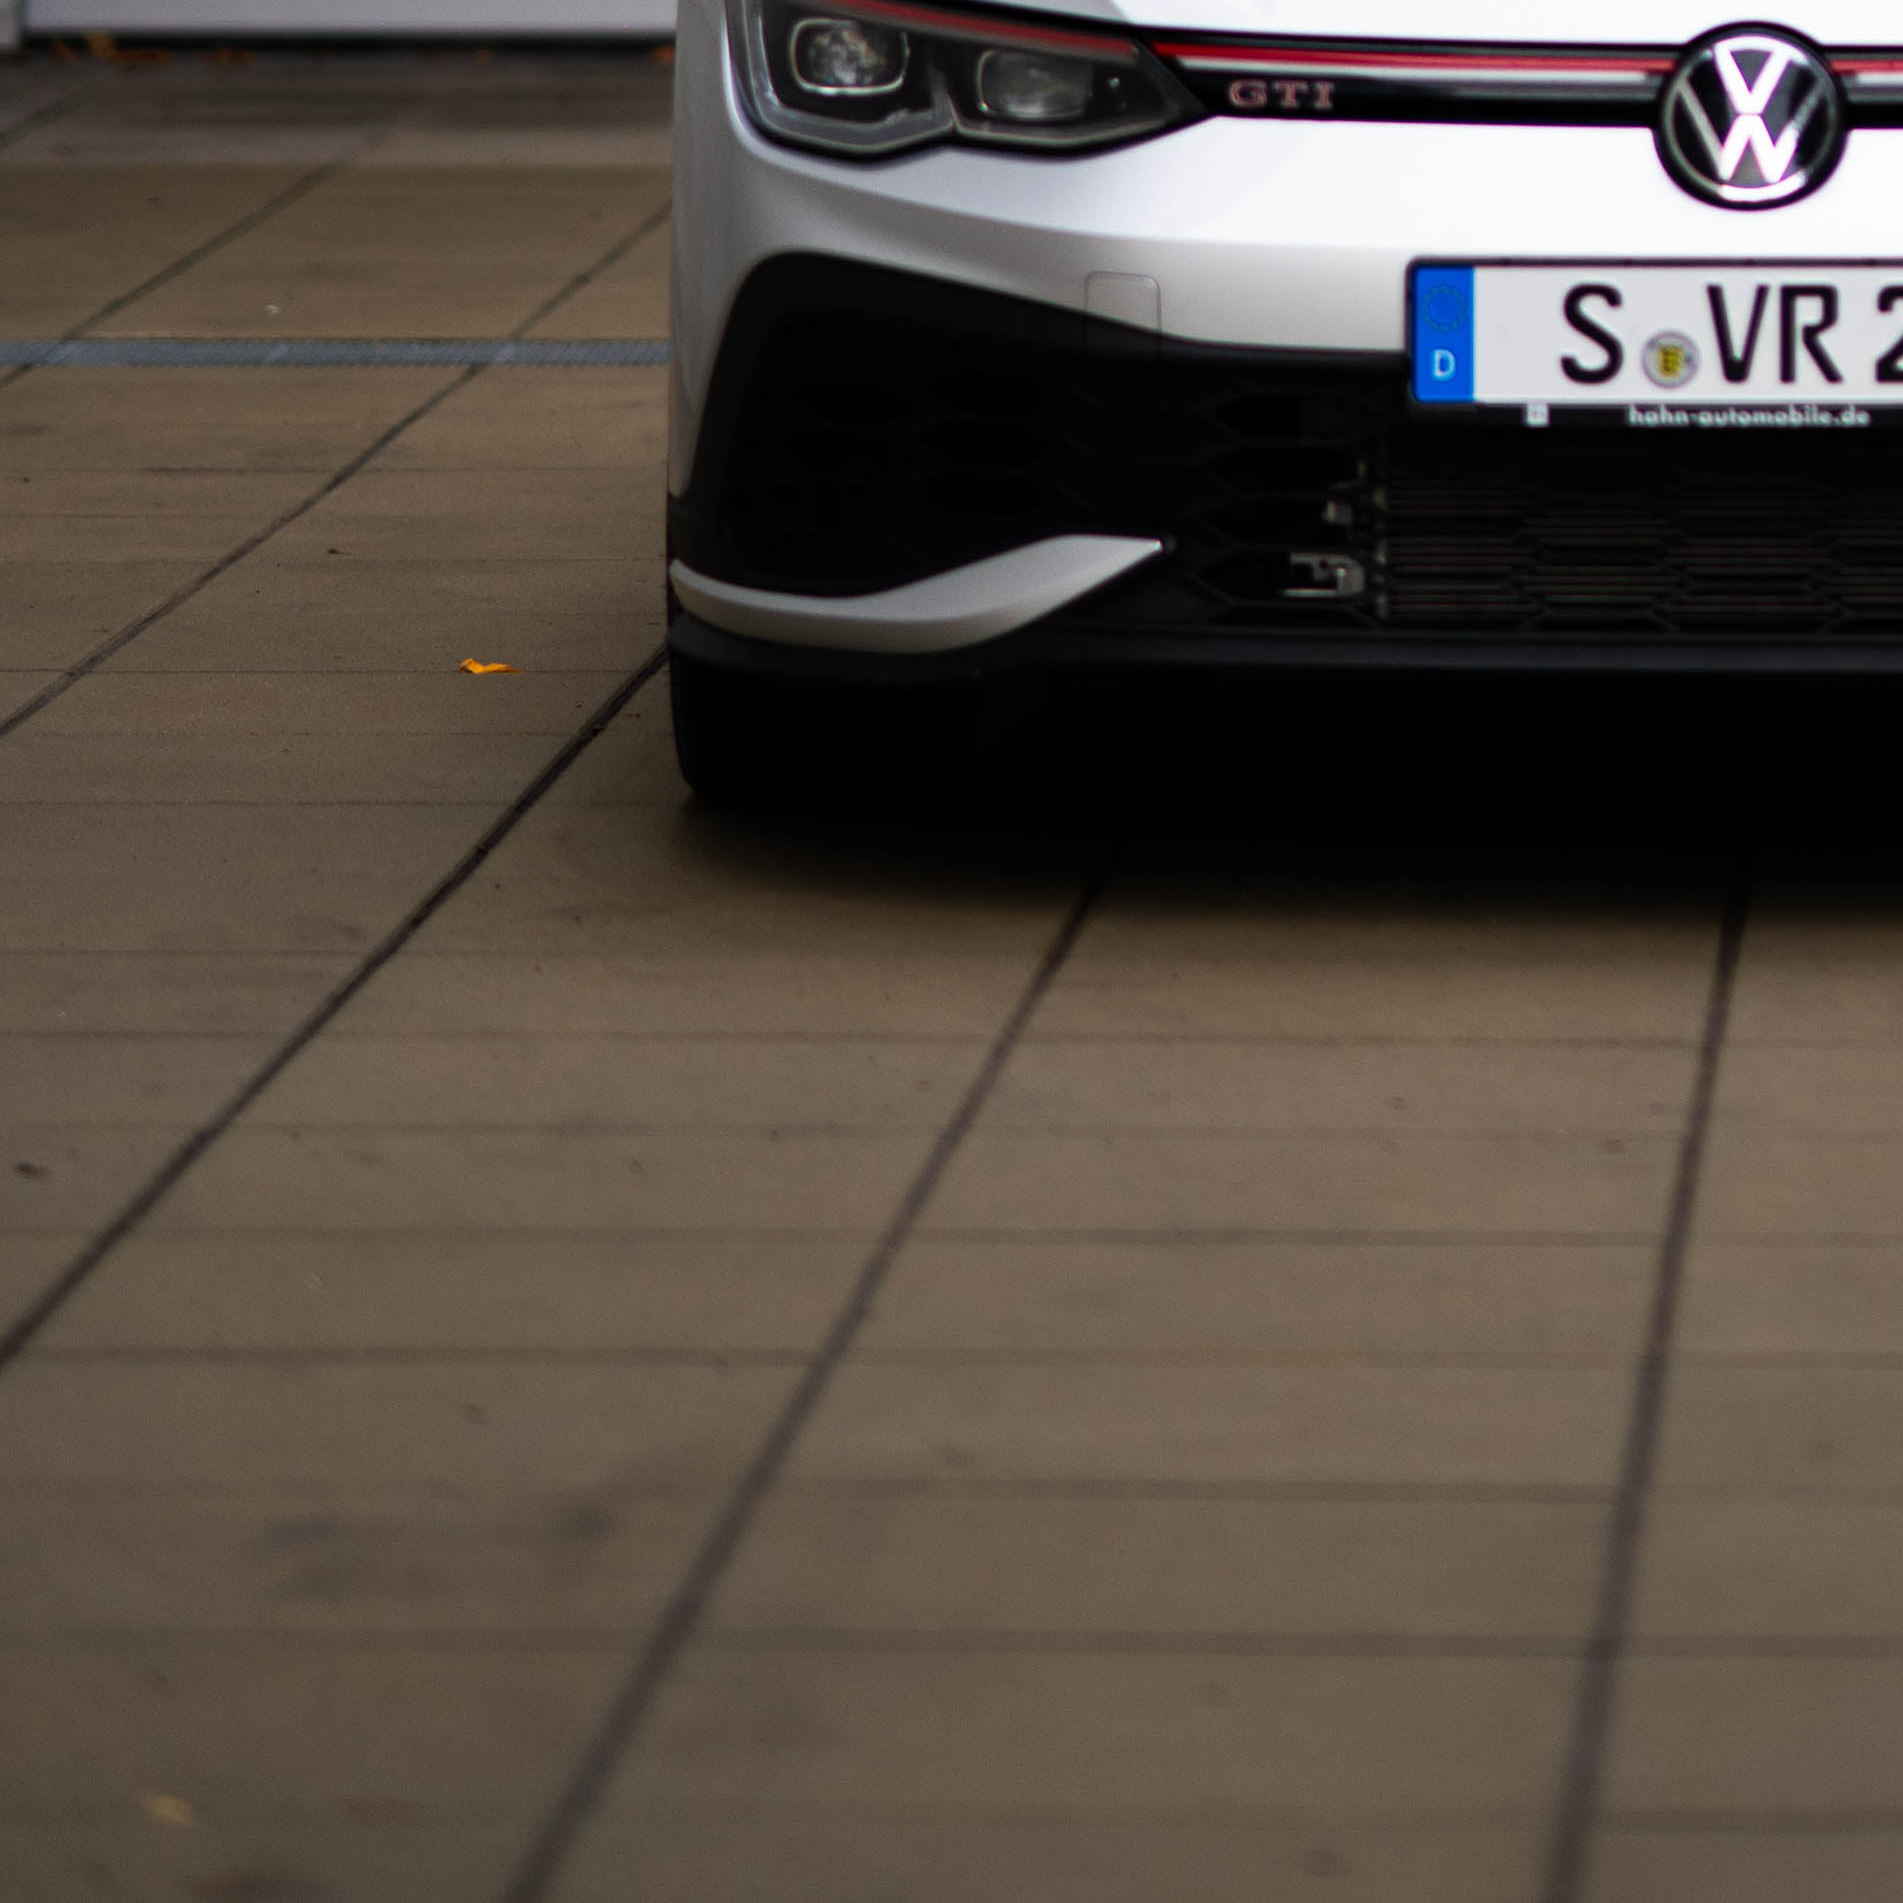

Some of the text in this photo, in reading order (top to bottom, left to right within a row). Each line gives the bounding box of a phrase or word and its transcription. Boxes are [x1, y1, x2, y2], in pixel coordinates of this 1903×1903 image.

[1229, 79, 1335, 109] GTI
[1560, 283, 1624, 385] S
[1706, 284, 1843, 384] VR
[1431, 348, 1456, 379] D
[1628, 404, 1871, 427] hahn-automobile.de
